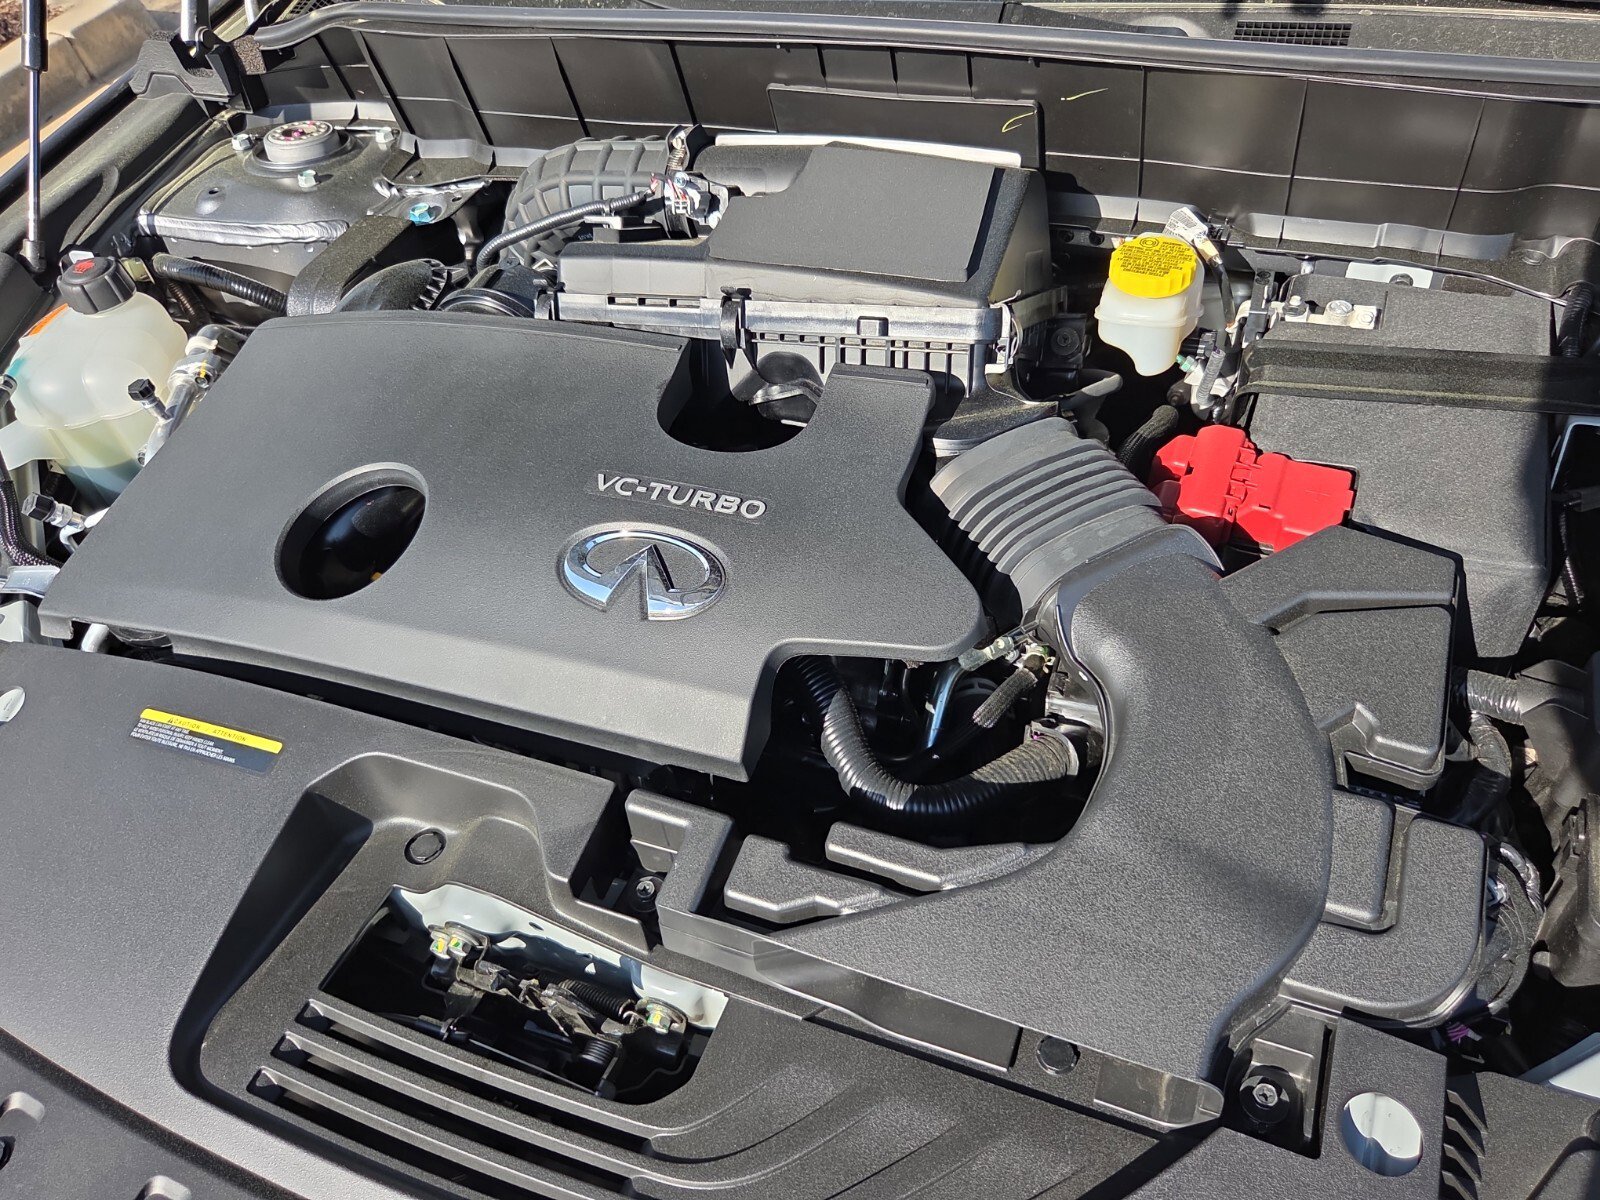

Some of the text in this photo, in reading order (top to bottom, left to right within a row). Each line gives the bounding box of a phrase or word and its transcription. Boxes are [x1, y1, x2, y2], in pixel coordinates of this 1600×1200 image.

[597, 473, 767, 519] VC-TURBO
[173, 718, 200, 730] CAUTION
[212, 729, 247, 742] ATTENTION
